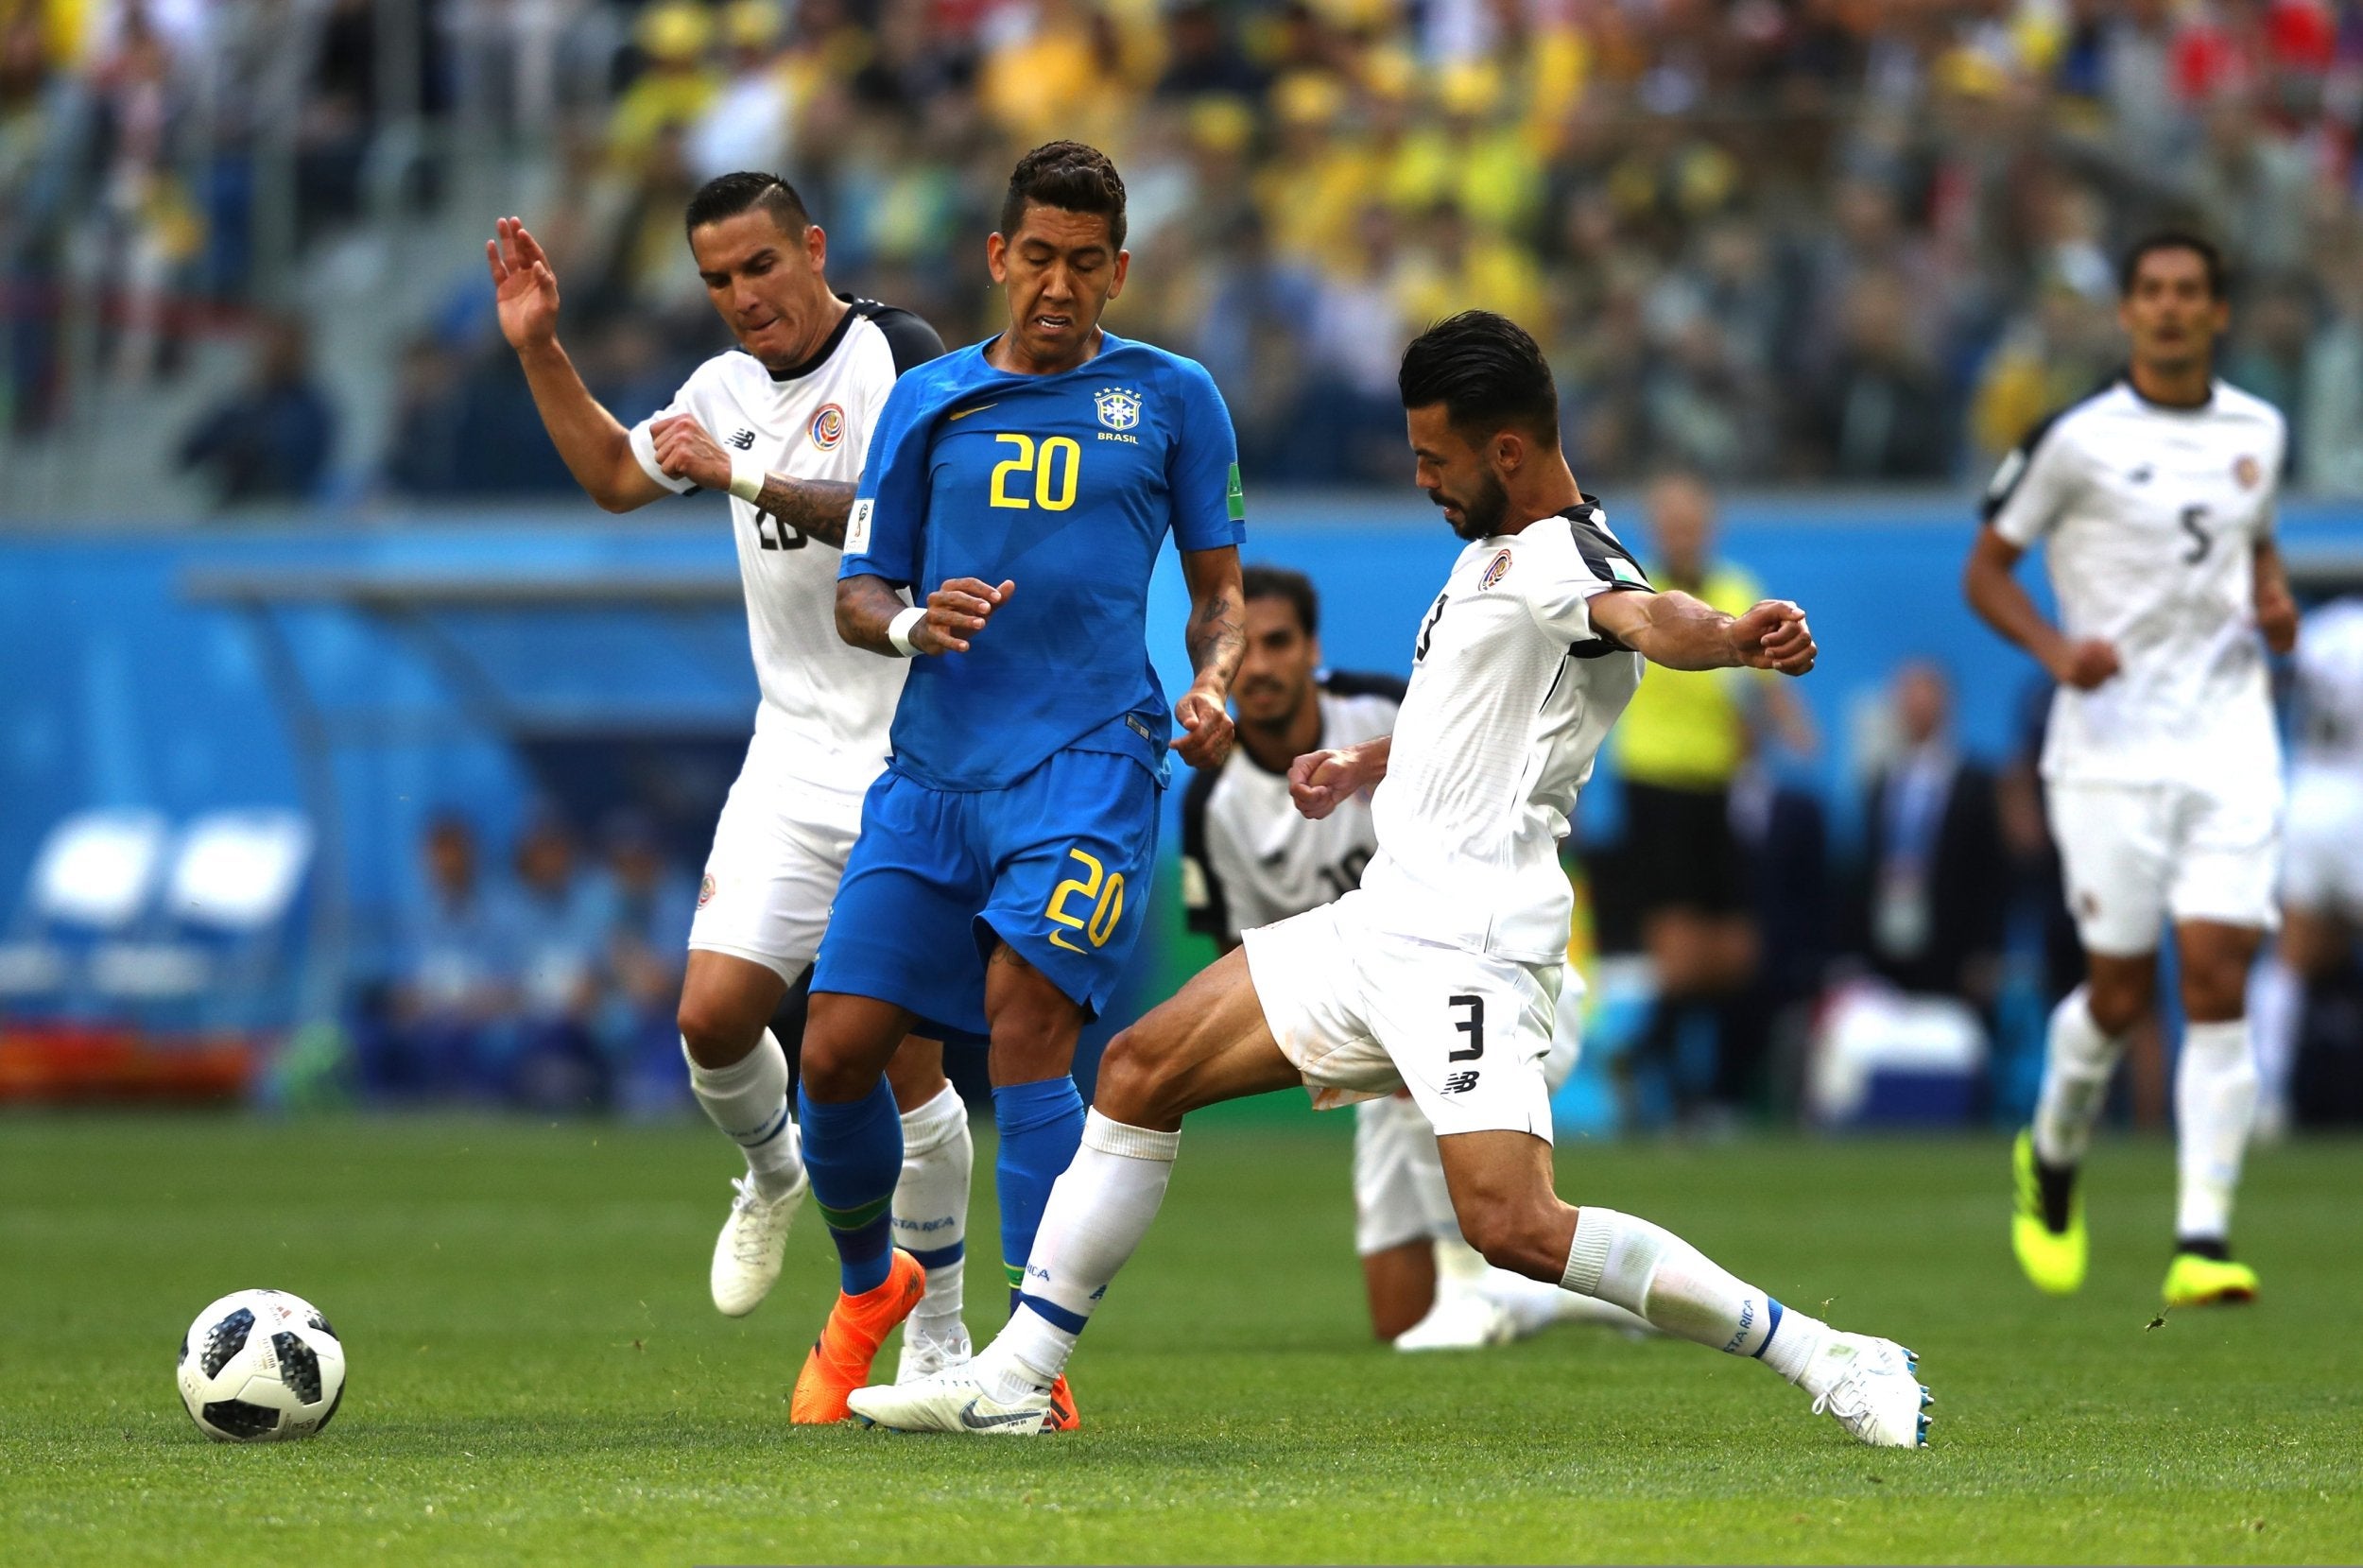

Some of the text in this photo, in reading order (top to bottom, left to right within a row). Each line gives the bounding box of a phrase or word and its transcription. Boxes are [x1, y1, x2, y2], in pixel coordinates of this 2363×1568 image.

[1097, 432, 1139, 445] BRASIL
[990, 433, 1081, 511] 20
[2180, 505, 2213, 565] 5
[1044, 848, 1125, 948] 20
[1448, 994, 1484, 1063] 3
[1739, 1299, 1754, 1330] RICA
